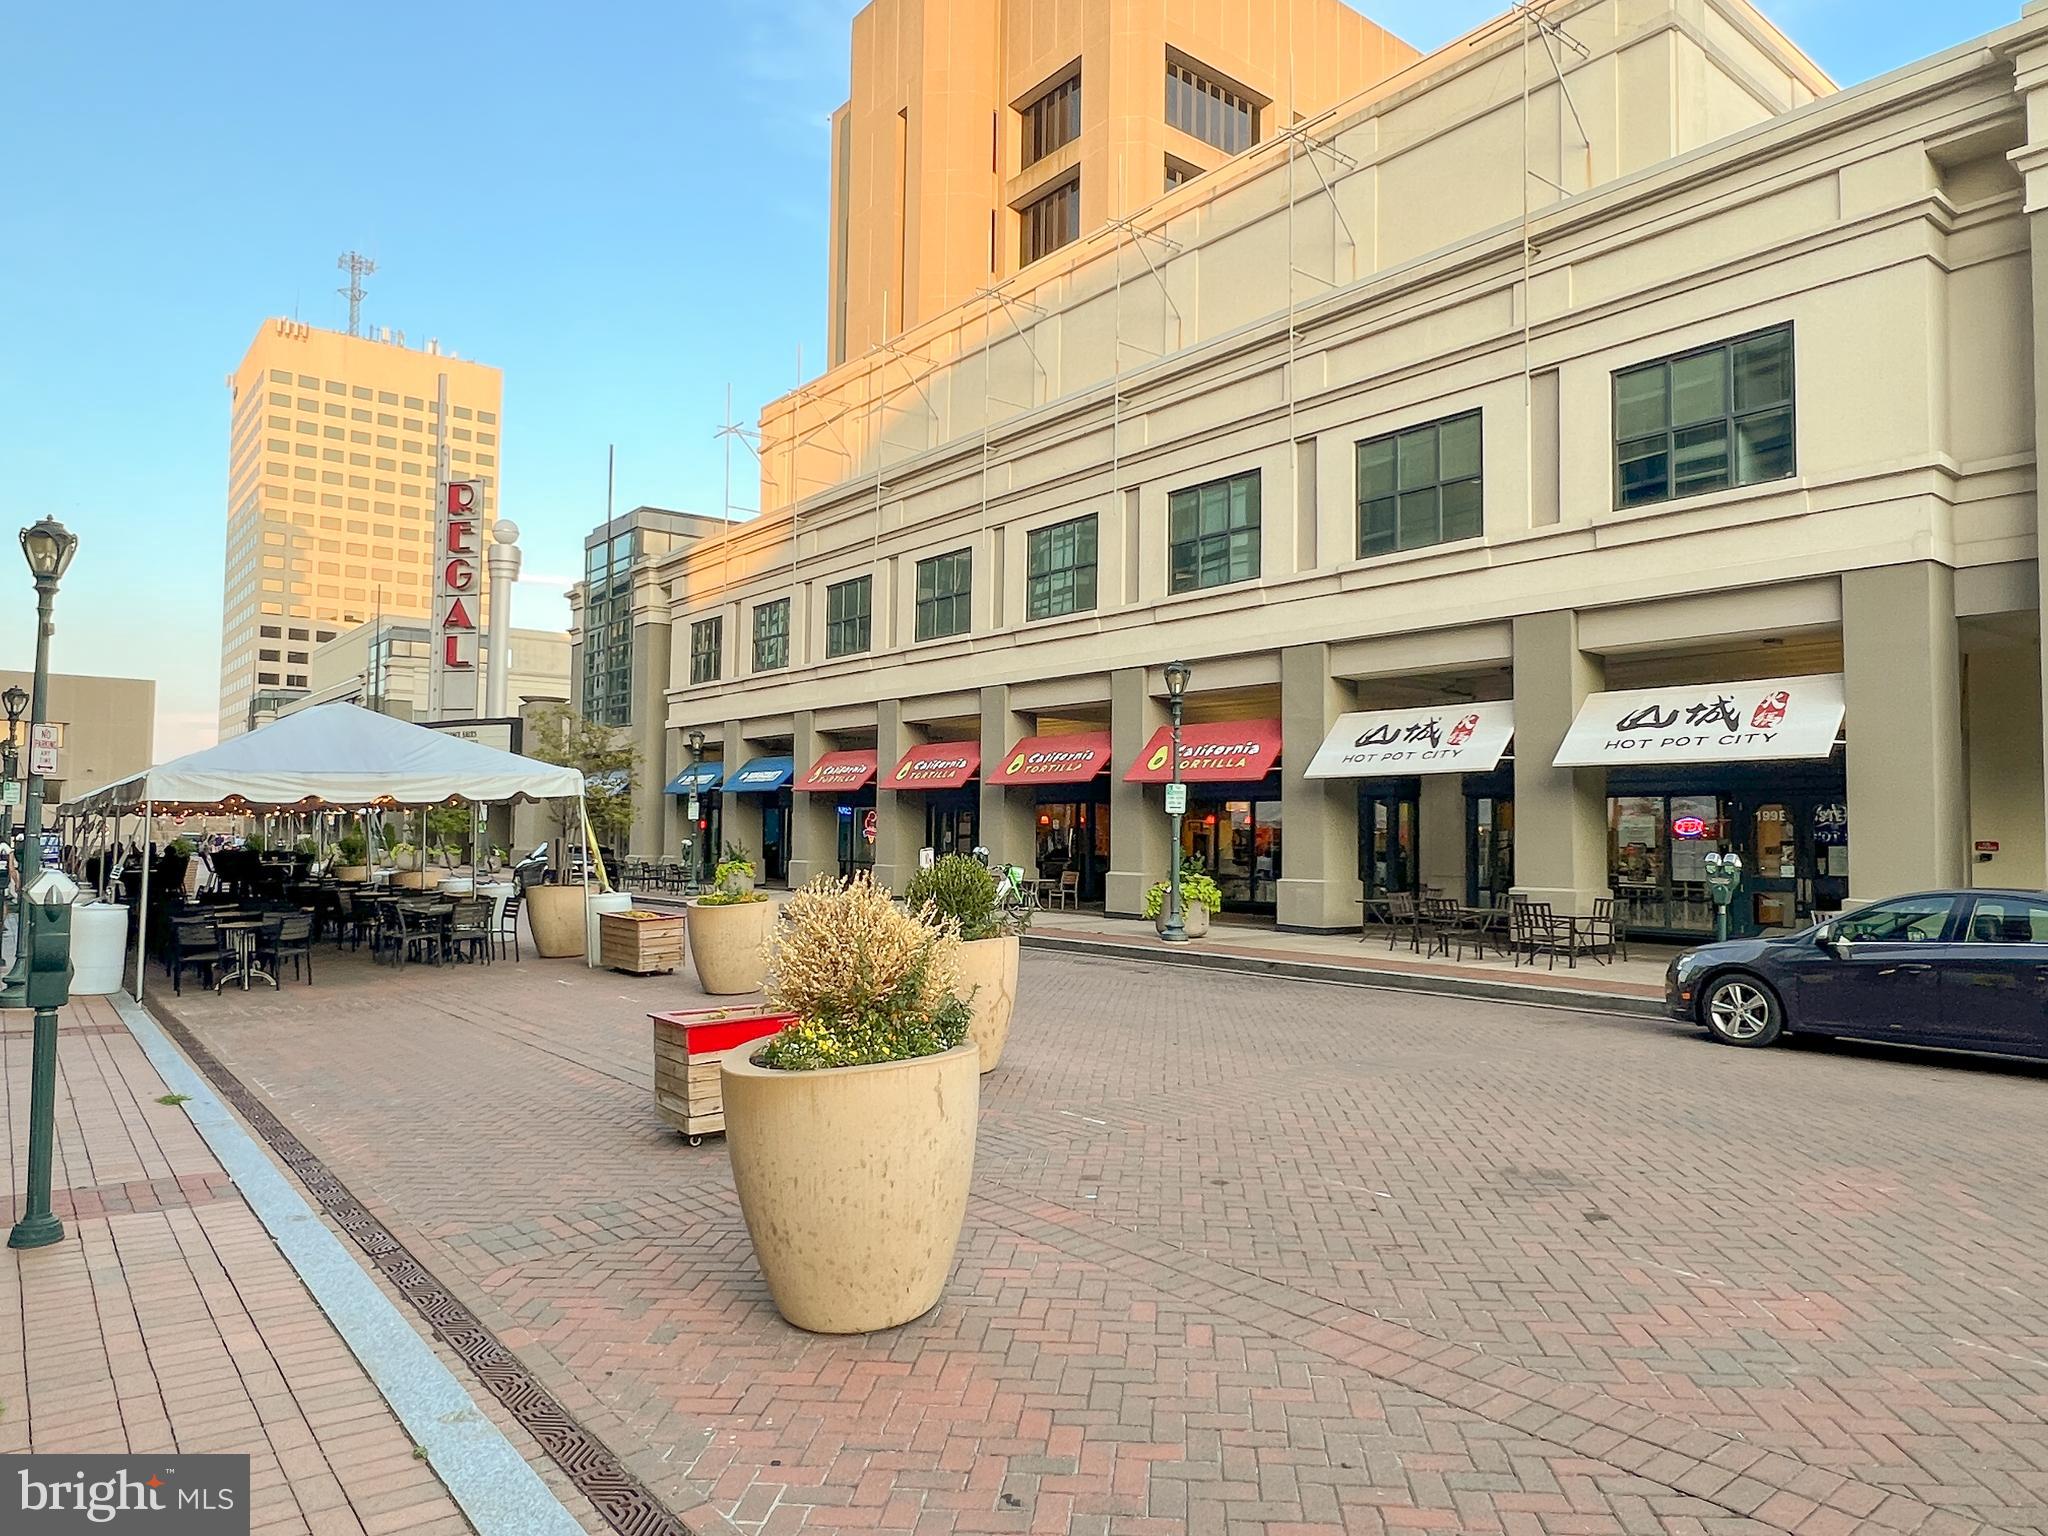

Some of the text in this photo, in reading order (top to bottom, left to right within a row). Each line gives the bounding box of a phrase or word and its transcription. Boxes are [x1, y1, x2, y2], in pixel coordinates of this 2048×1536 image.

[442, 484, 475, 668] REGAL
[1616, 695, 1741, 732] 山城
[41, 729, 51, 739] NO
[1354, 716, 1443, 749] 山城
[1604, 732, 1778, 751] HOT POT CITY
[1028, 749, 1095, 763] California
[1342, 749, 1464, 764] HOT POT CITY
[822, 763, 867, 775] California
[913, 758, 968, 770] California
[1024, 763, 1083, 774] TORTILLA
[817, 775, 857, 783] TORTILLA
[909, 770, 956, 780] TORTILLA
[1755, 810, 1786, 821] 199E
